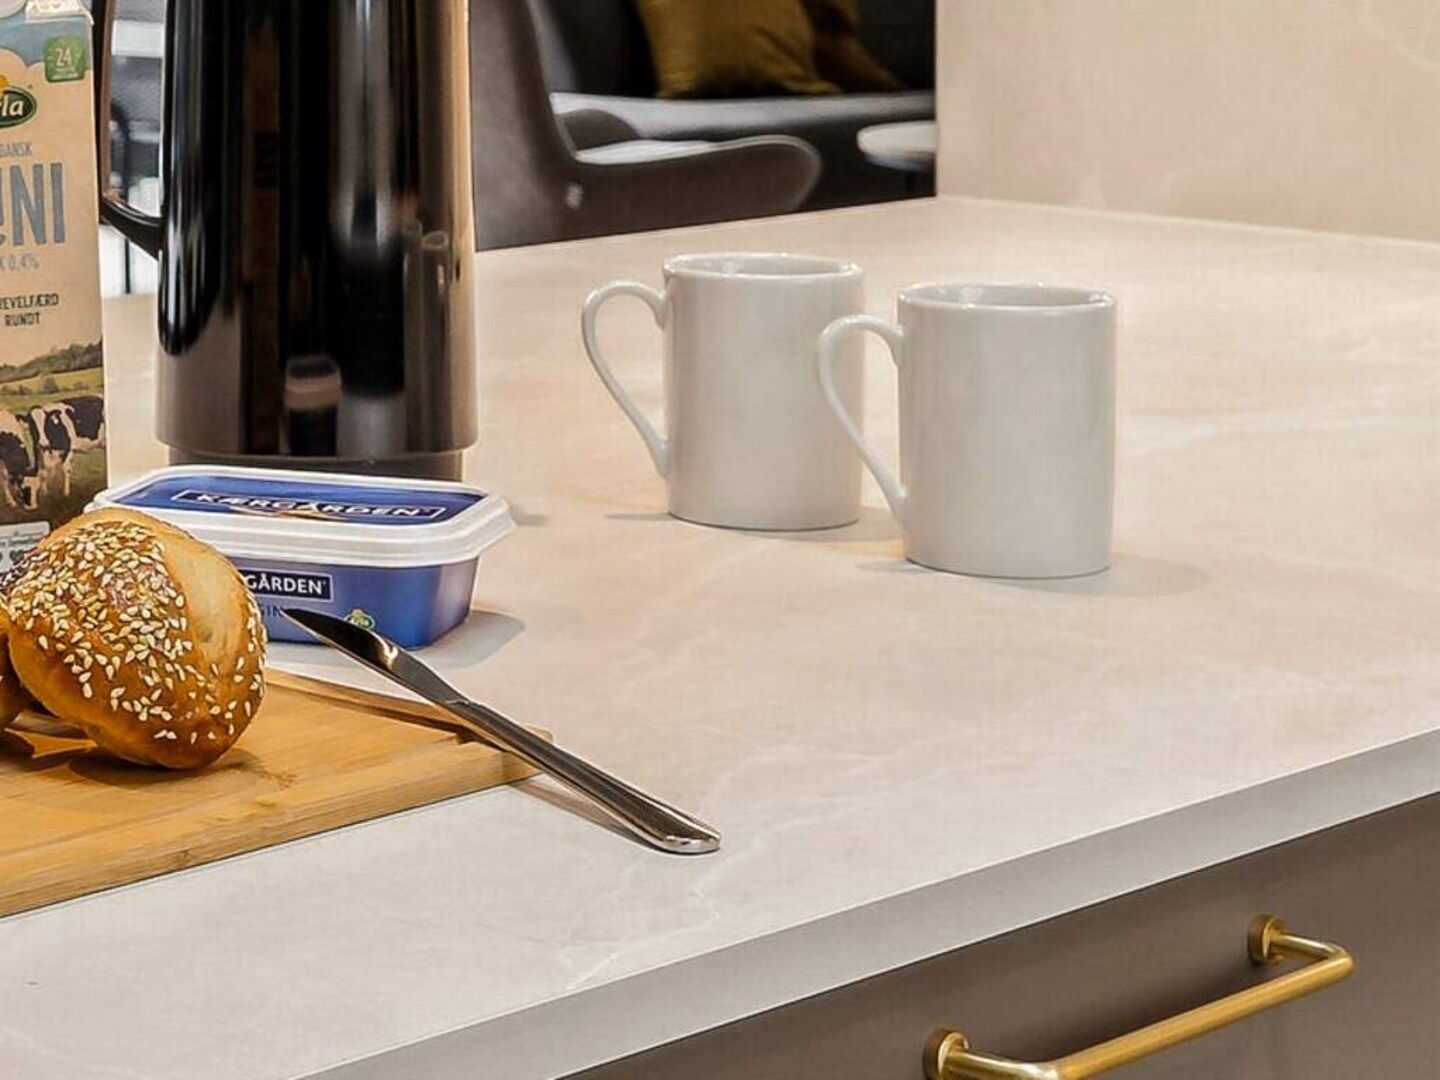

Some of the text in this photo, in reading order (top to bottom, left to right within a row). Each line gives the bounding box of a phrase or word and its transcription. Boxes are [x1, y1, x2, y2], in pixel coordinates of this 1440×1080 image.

[55, 47, 72, 67] 24
[5, 311, 41, 327] RUNDT
[245, 571, 323, 595] GÅRDEN
